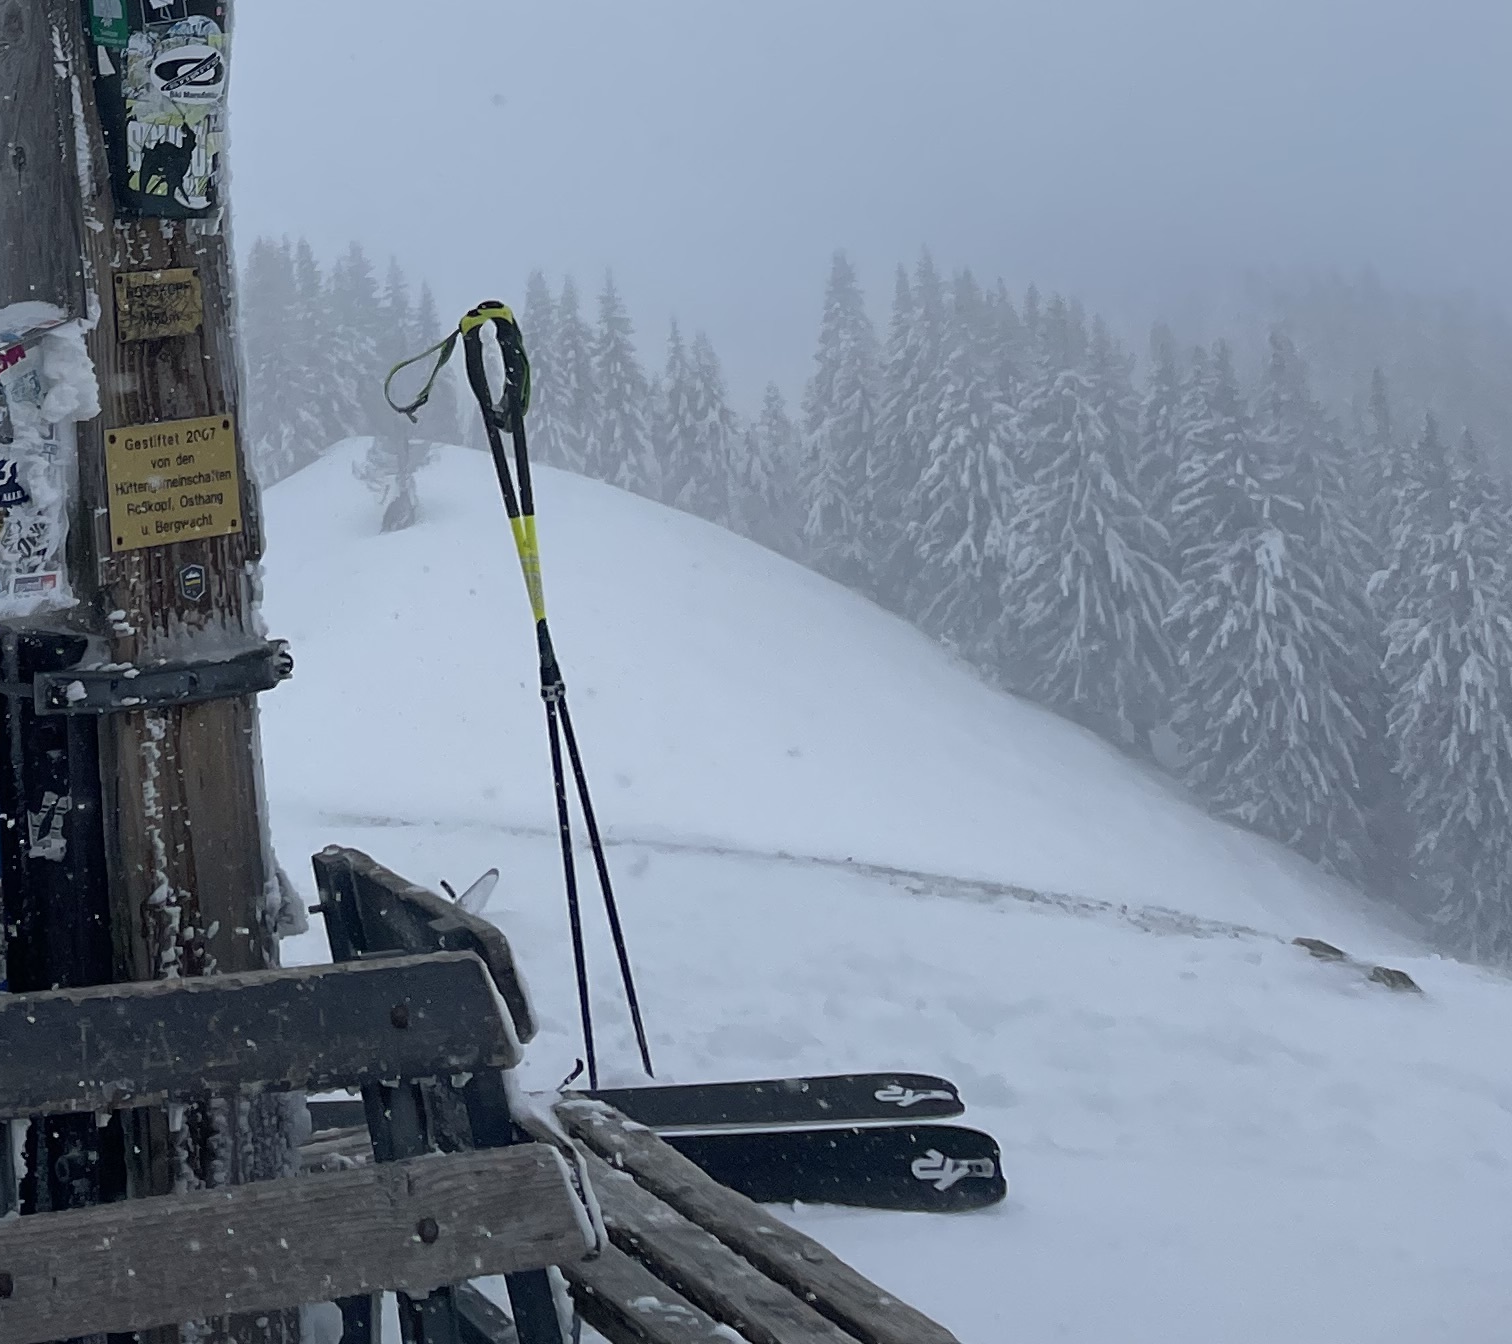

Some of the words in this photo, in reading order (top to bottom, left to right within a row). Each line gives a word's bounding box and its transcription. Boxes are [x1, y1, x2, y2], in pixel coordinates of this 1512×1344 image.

[124, 433, 179, 451] Gestiftet
[186, 427, 216, 444] 2007
[151, 457, 171, 469] von
[176, 453, 195, 466] den
[115, 470, 232, 496] Hüttengmeinschaften
[1, 490, 23, 502] ALLE
[180, 492, 223, 508] Osthang
[155, 513, 213, 534] Bergwacht
